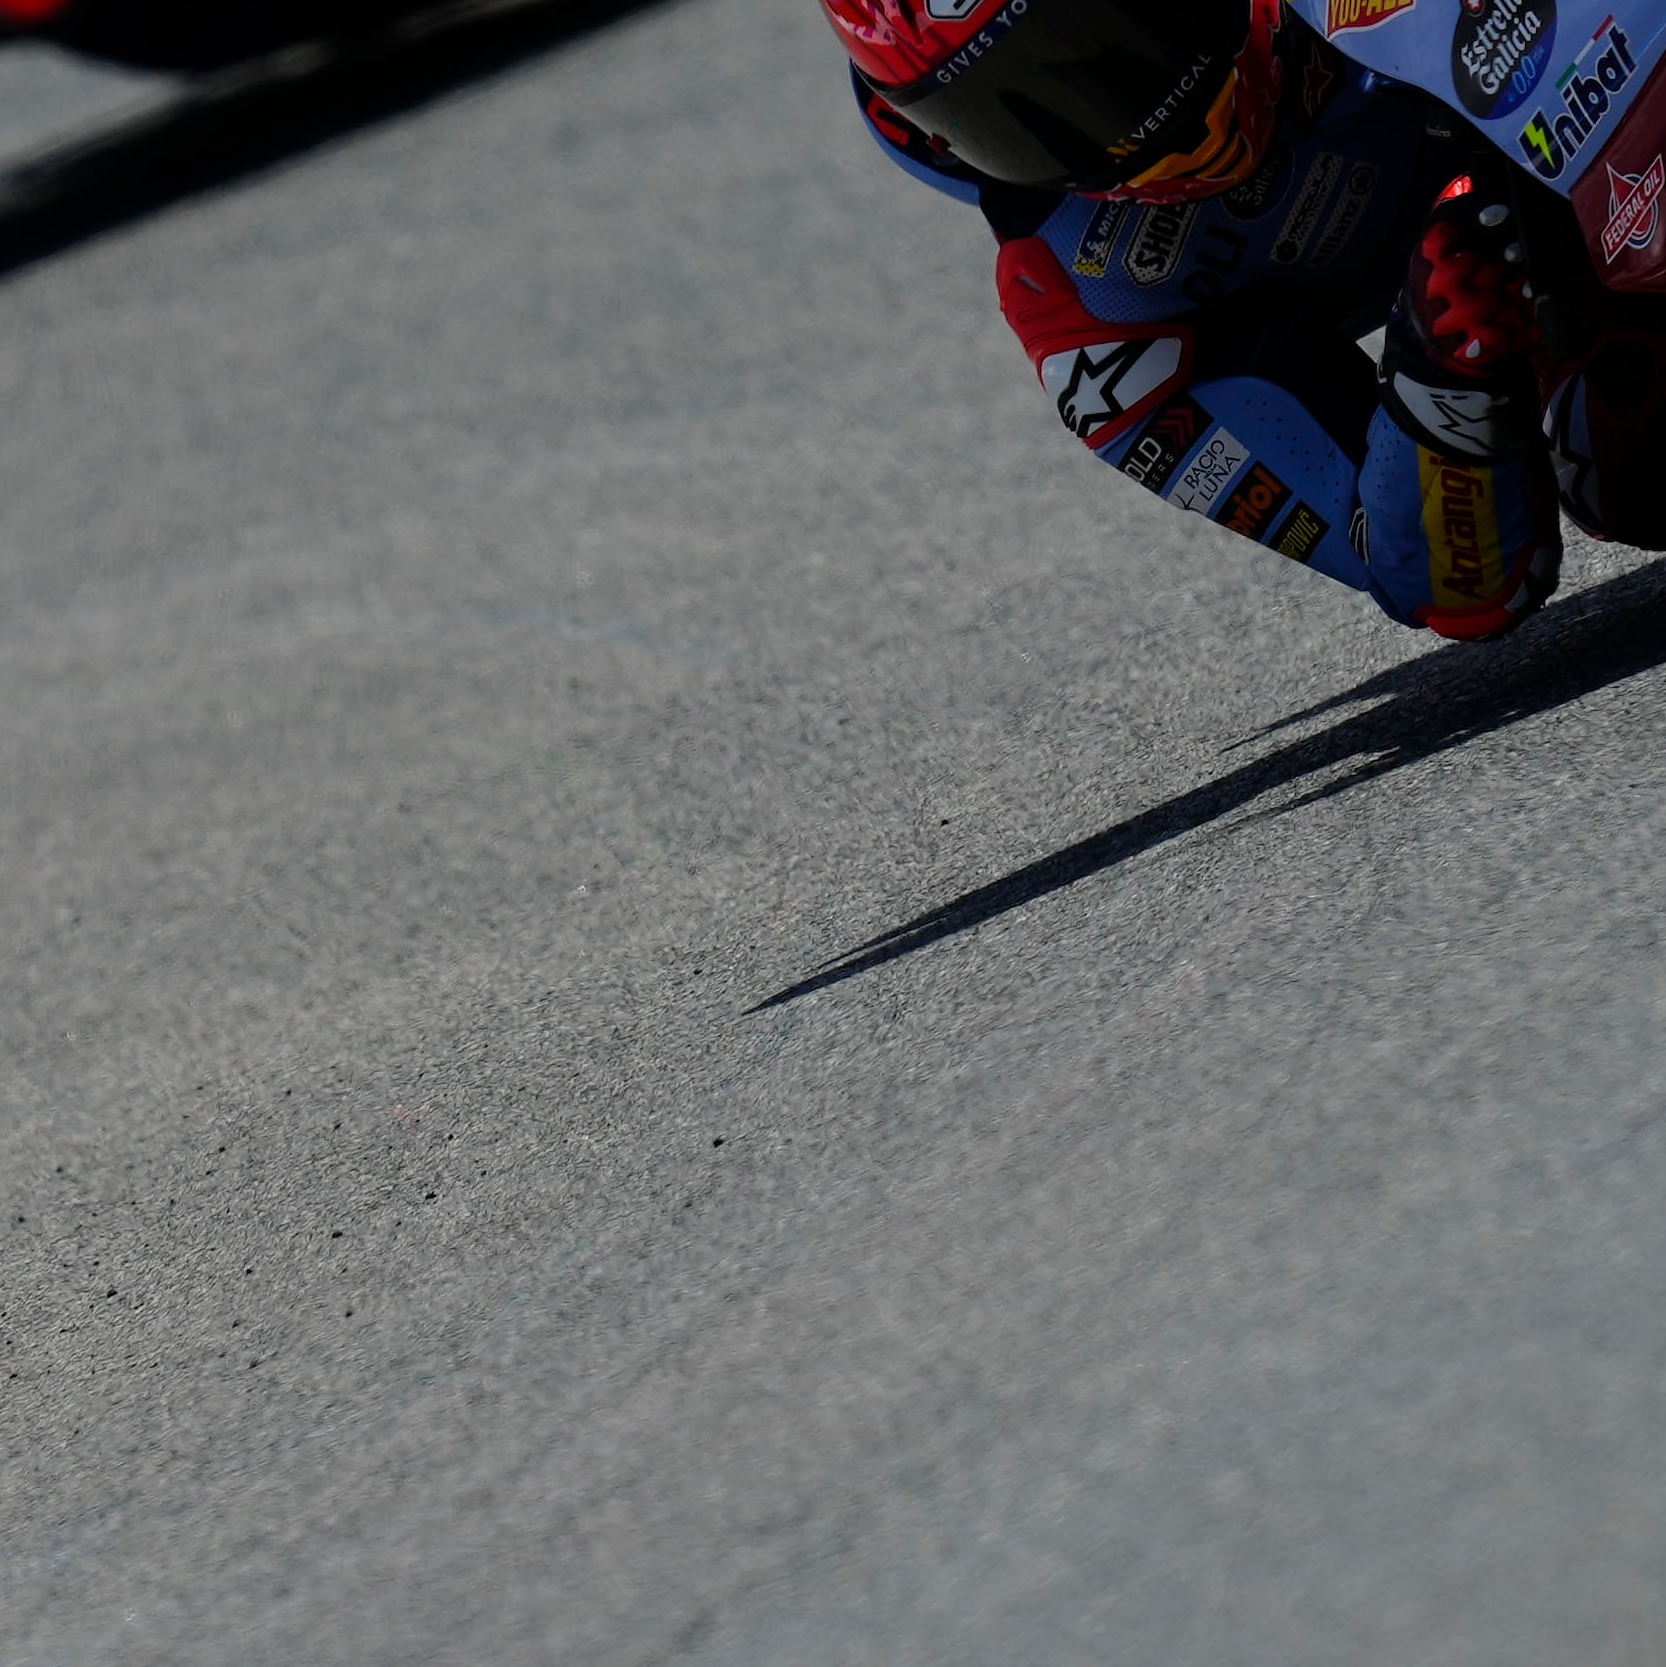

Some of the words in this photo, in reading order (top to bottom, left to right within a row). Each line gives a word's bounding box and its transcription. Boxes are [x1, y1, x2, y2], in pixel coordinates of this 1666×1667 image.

[936, 33, 995, 85] GIVES
[1479, 10, 1543, 95] Galicia
[1517, 22, 1639, 181] Unibat
[1099, 199, 1124, 236] MIC
[1135, 200, 1189, 278] SHOE
[1605, 197, 1644, 250] FEDERAL
[1642, 170, 1662, 200] OIL
[1123, 435, 1163, 483] OLD
[1148, 452, 1175, 487] ERS
[1199, 454, 1241, 502] LUNA
[1429, 455, 1486, 601] Antangi
